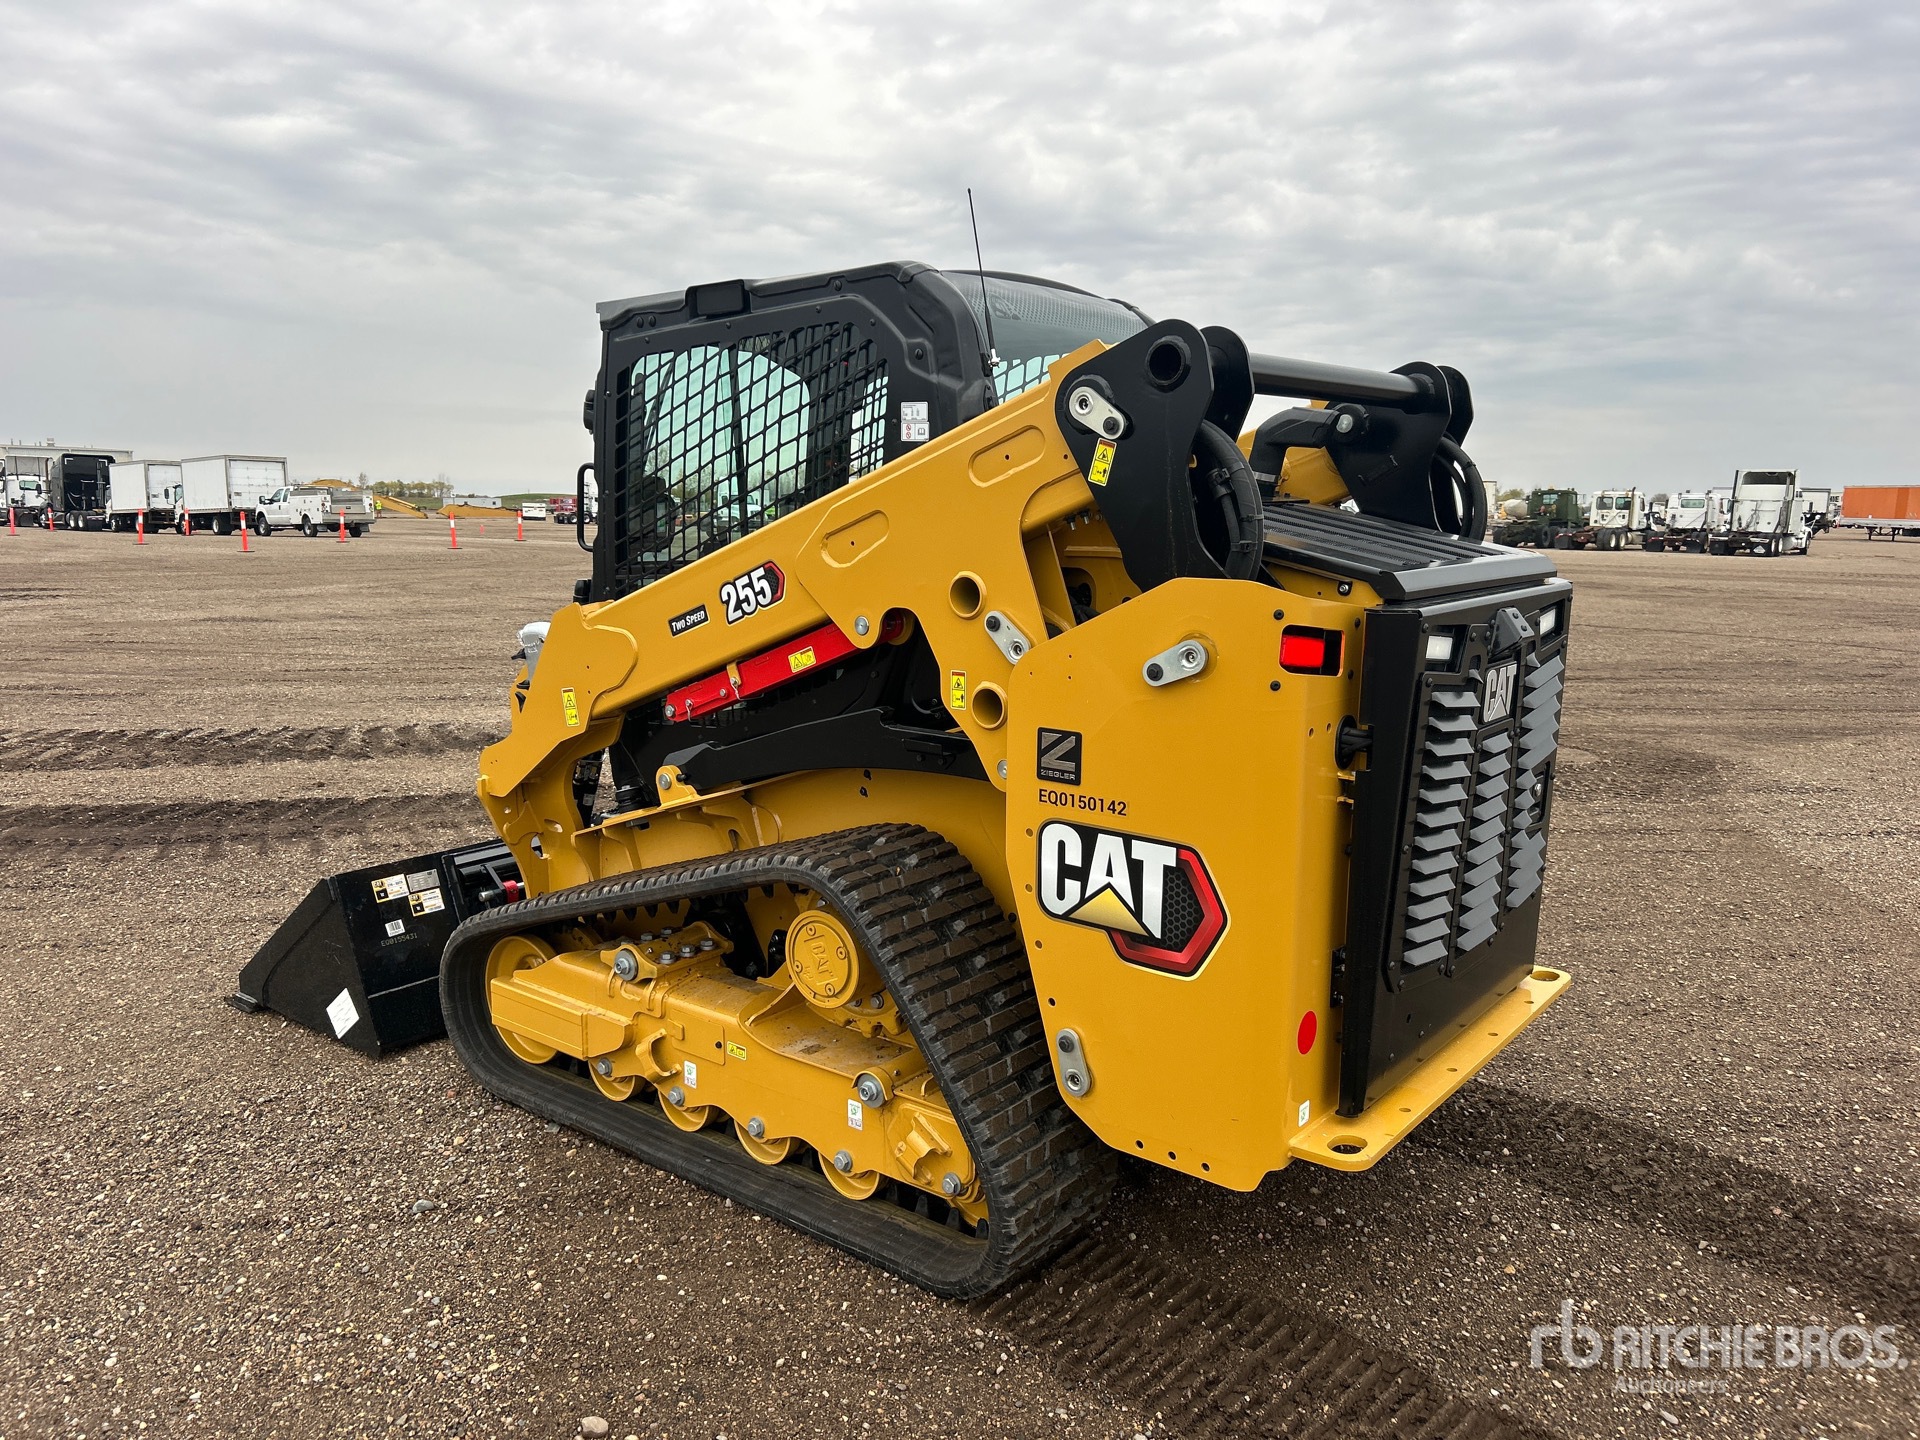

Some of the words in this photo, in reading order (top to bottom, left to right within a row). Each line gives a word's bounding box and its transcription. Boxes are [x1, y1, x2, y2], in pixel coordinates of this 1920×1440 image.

[721, 566, 772, 622] 255
[1483, 663, 1518, 723] CAT
[1038, 788, 1127, 817] EQ0150142
[1040, 769, 1076, 781] ZIEGLER
[1041, 823, 1177, 939] CAT
